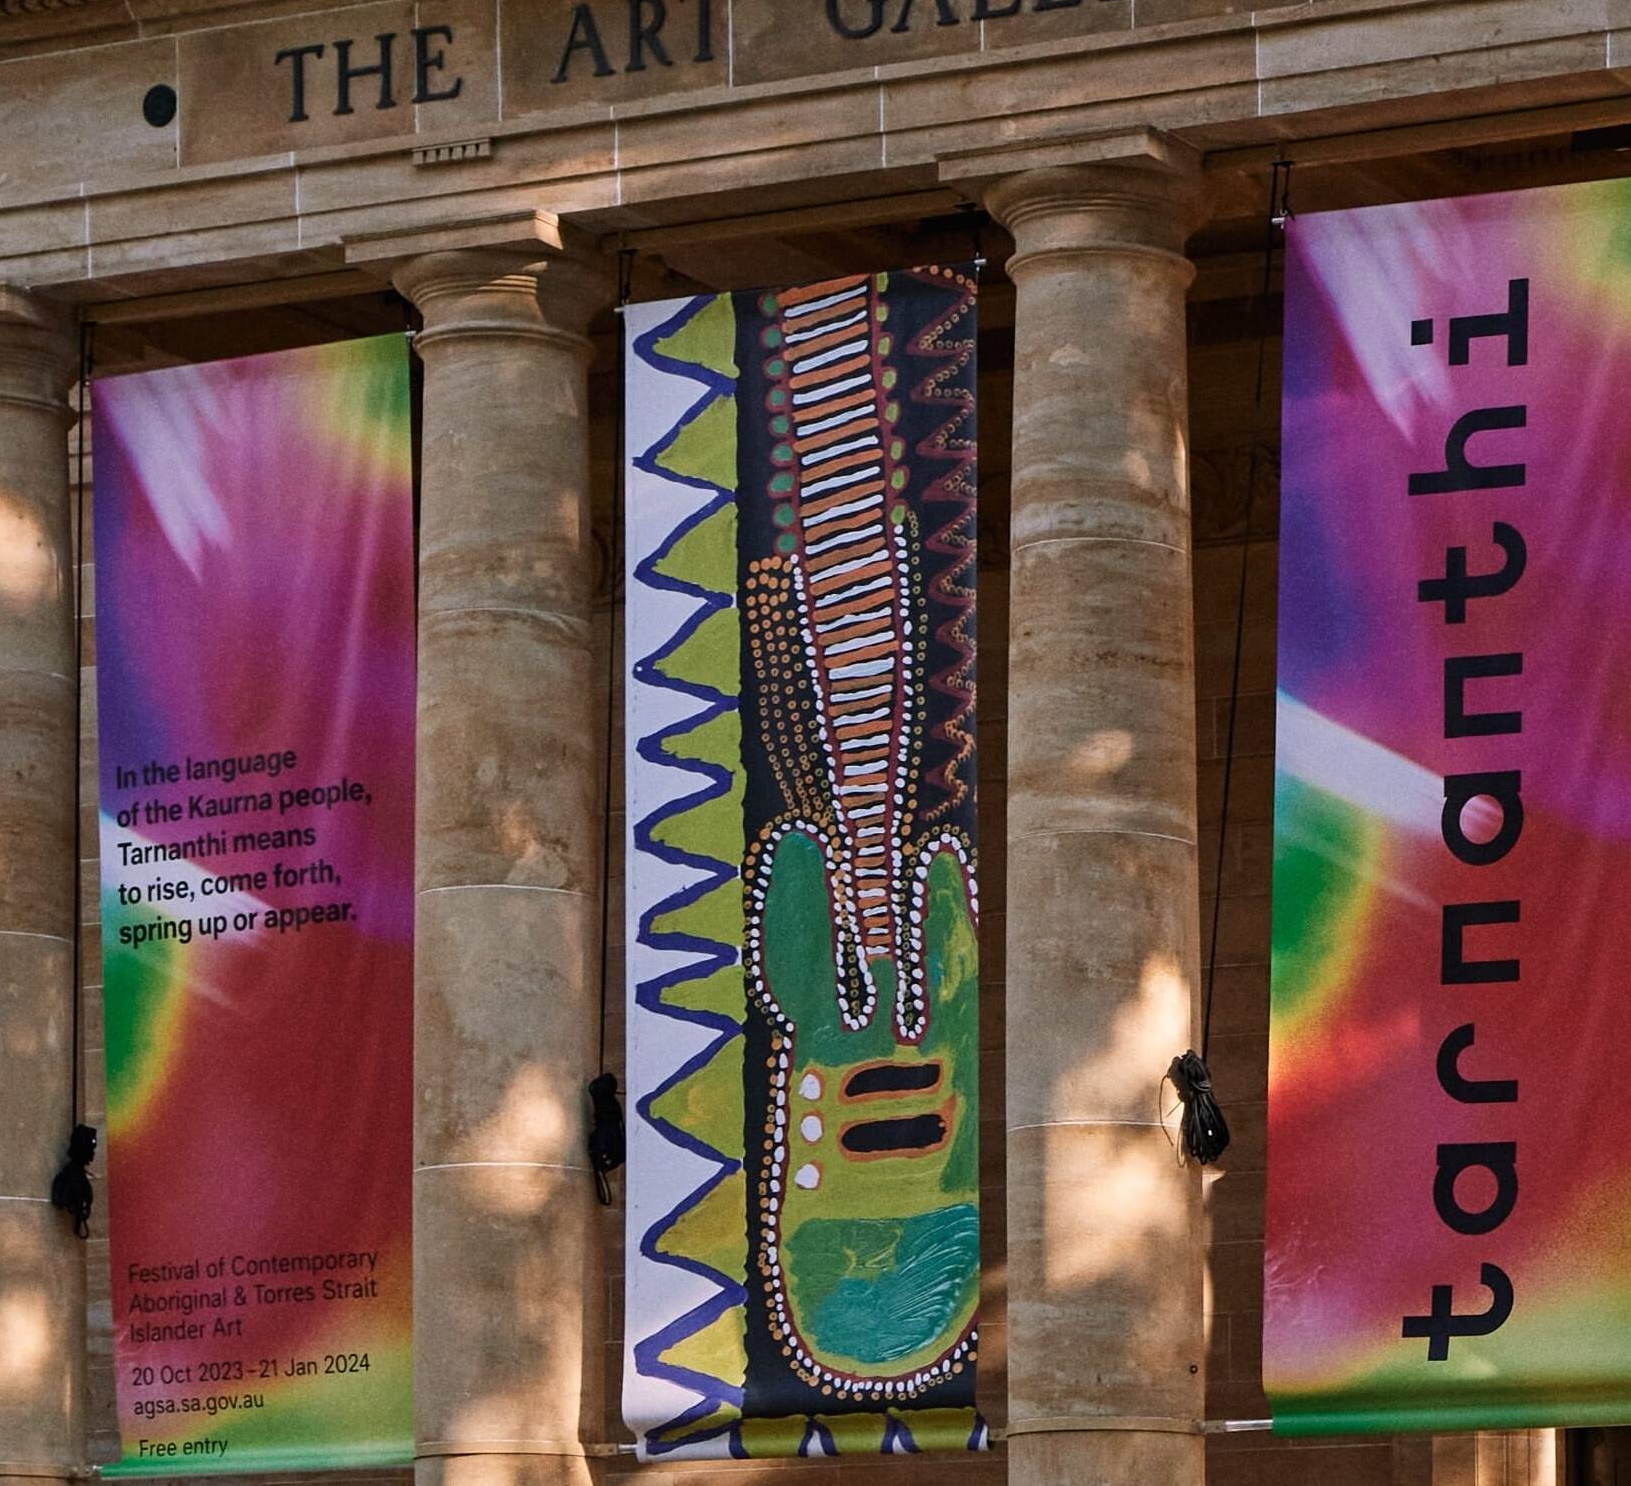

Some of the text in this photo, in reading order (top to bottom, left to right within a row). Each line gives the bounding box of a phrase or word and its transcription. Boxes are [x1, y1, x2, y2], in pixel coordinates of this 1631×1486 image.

[275, 24, 462, 123] THE
[116, 750, 297, 790] In the language
[117, 778, 372, 828] of the Kaurna people,
[1402, 278, 1531, 1361] tarnanthi
[118, 827, 316, 866] Tarnanthi means
[118, 858, 341, 905] to rise, come forth,
[119, 901, 357, 949] spring up or appear.
[129, 1250, 378, 1284] Festival of Contemporary
[130, 1278, 378, 1315] Aboriginal & Torres Strait
[130, 1318, 242, 1343] Islander Art
[132, 1367, 154, 1387] 20
[160, 1365, 192, 1384] Oct
[284, 1358, 317, 1377] Jan
[324, 1353, 370, 1375] 2024
[134, 1392, 264, 1419] agsa.sa.gov.au
[139, 1437, 228, 1457] Free entry
